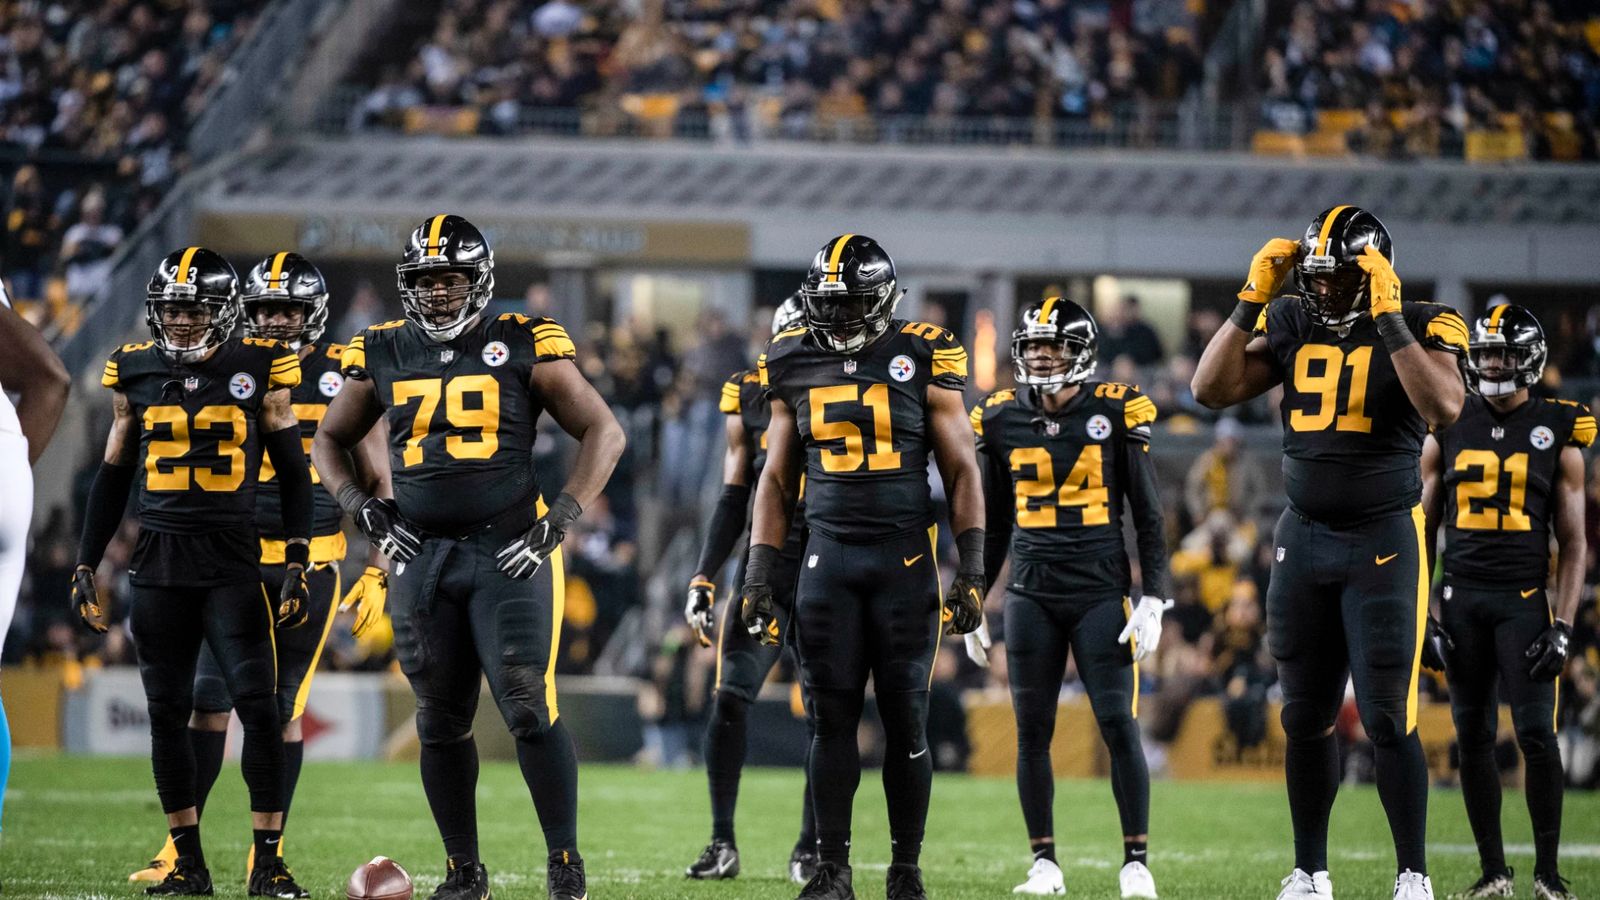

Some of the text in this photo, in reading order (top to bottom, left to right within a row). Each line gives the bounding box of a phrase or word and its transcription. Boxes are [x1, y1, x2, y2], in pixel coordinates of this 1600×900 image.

[168, 265, 197, 283] 23
[1032, 308, 1059, 323] 24
[392, 374, 500, 467] 79
[809, 383, 902, 471] 51
[1290, 344, 1374, 433] 91
[143, 405, 247, 491] 23
[1008, 445, 1110, 528] 24
[1454, 449, 1531, 531] 21
